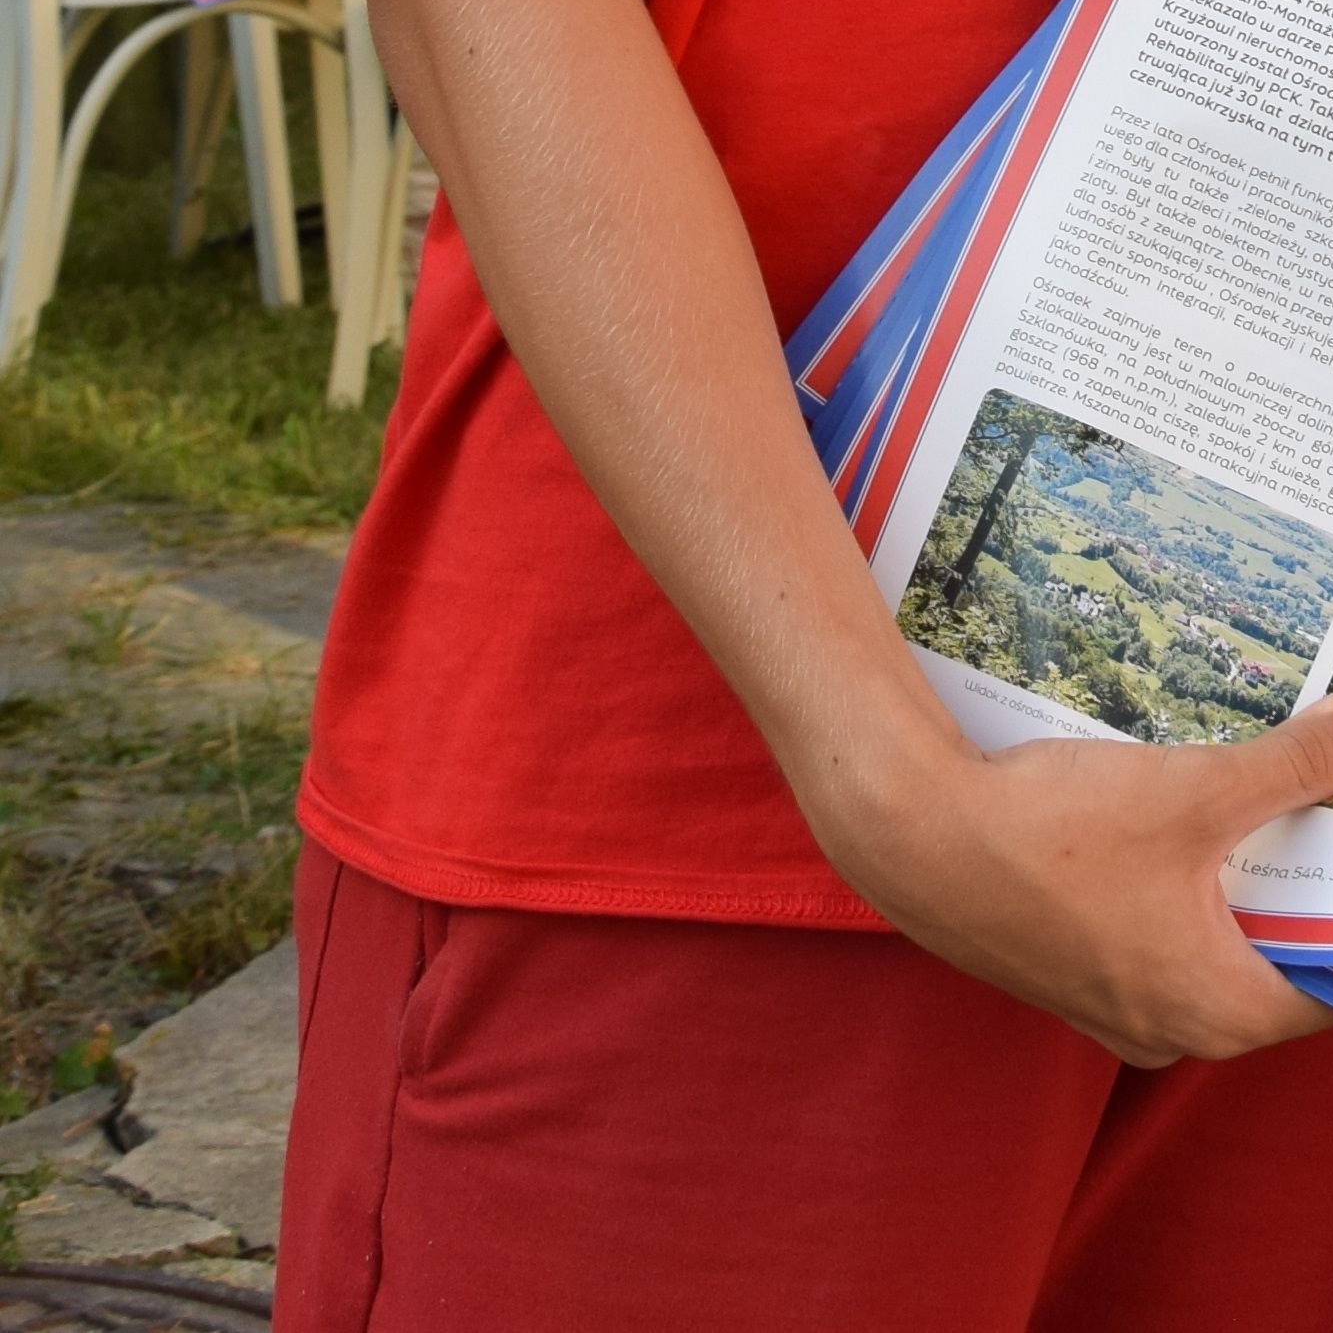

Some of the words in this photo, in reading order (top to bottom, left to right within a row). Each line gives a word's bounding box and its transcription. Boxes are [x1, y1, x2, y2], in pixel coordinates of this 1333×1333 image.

[1154, 18, 1238, 61] utworzony
[1240, 53, 1289, 80] został
[1162, 0, 1235, 37] Krzyżowi
[1260, 21, 1275, 33] w
[1277, 28, 1322, 53] darze
[1138, 51, 1208, 87] trwająca
[1207, 80, 1234, 98] już
[1236, 90, 1258, 107] 30
[1260, 100, 1283, 118] lat
[1146, 34, 1266, 93] Rehabilitacyjny
[1268, 83, 1303, 107] PCK.
[1130, 69, 1265, 133] czerwonokrzyska
[1268, 126, 1289, 143] na
[1292, 135, 1324, 157] tym
[1241, 857, 1290, 880] Leśna
[1291, 866, 1325, 882] 54A,
